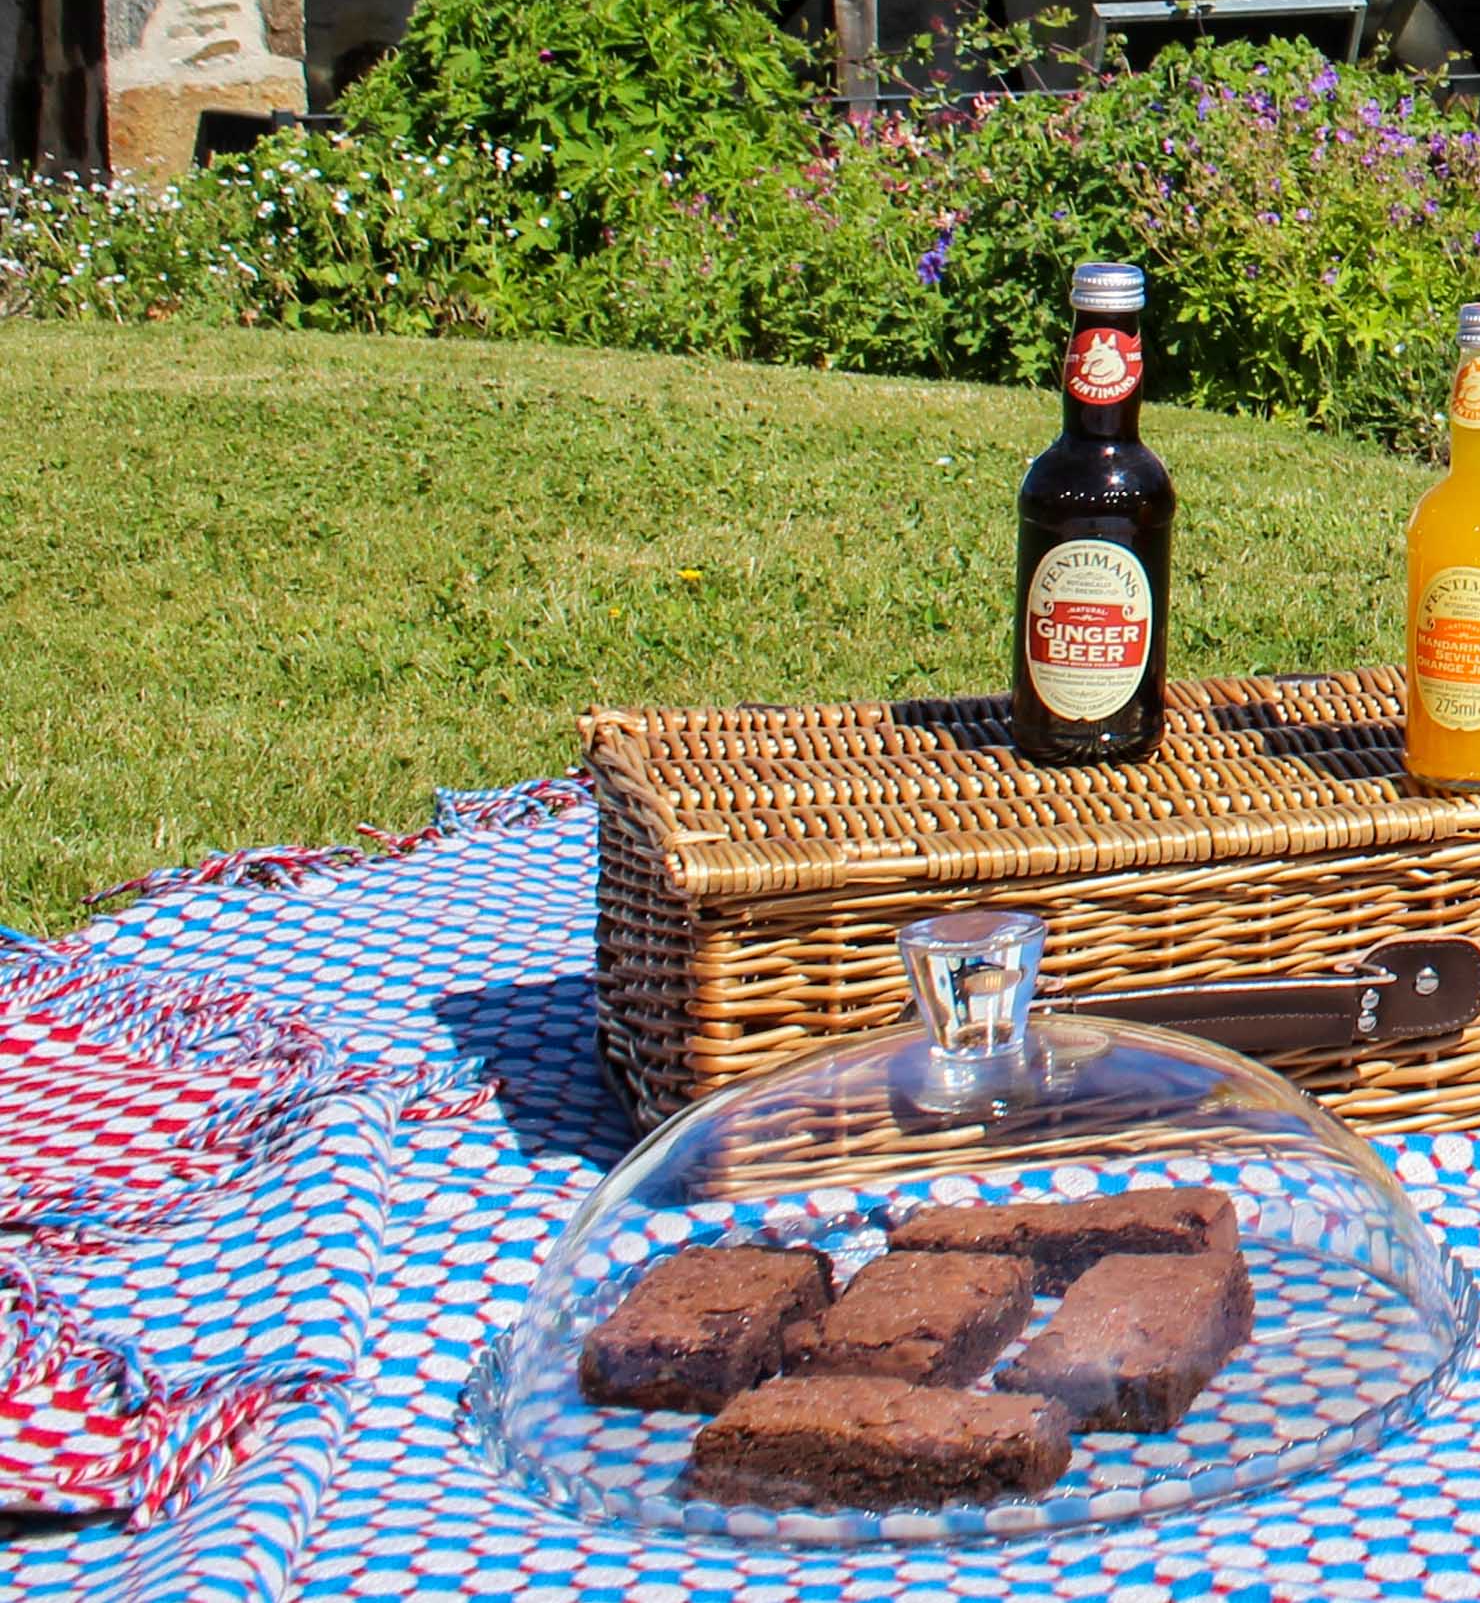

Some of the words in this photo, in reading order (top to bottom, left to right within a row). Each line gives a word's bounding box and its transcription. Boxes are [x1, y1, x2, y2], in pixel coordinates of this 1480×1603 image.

[1070, 376, 1136, 399] FENTIMANS
[1041, 551, 1137, 598] FENTIMANS
[1070, 604, 1106, 615] NATURAL
[1036, 618, 1140, 643] GINGER
[1048, 639, 1125, 662] BEER
[1417, 655, 1464, 674] ORANGE
[1435, 697, 1476, 716] 275ml
